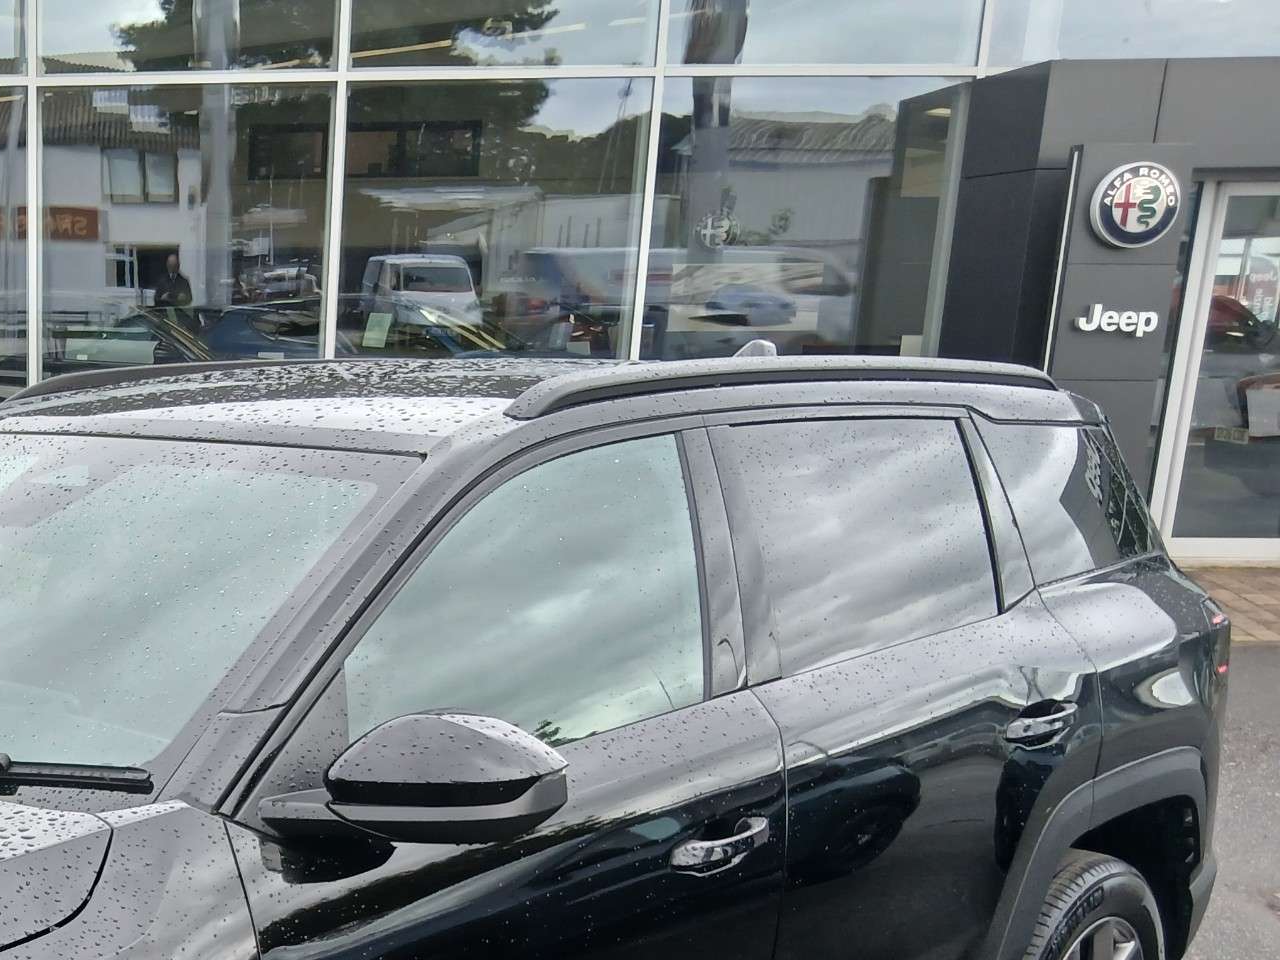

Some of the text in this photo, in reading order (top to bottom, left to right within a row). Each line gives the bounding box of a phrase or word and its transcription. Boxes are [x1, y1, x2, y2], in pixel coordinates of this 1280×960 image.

[1103, 167, 1176, 207] ALFA ROMEO
[1078, 303, 1159, 338] Jeep
